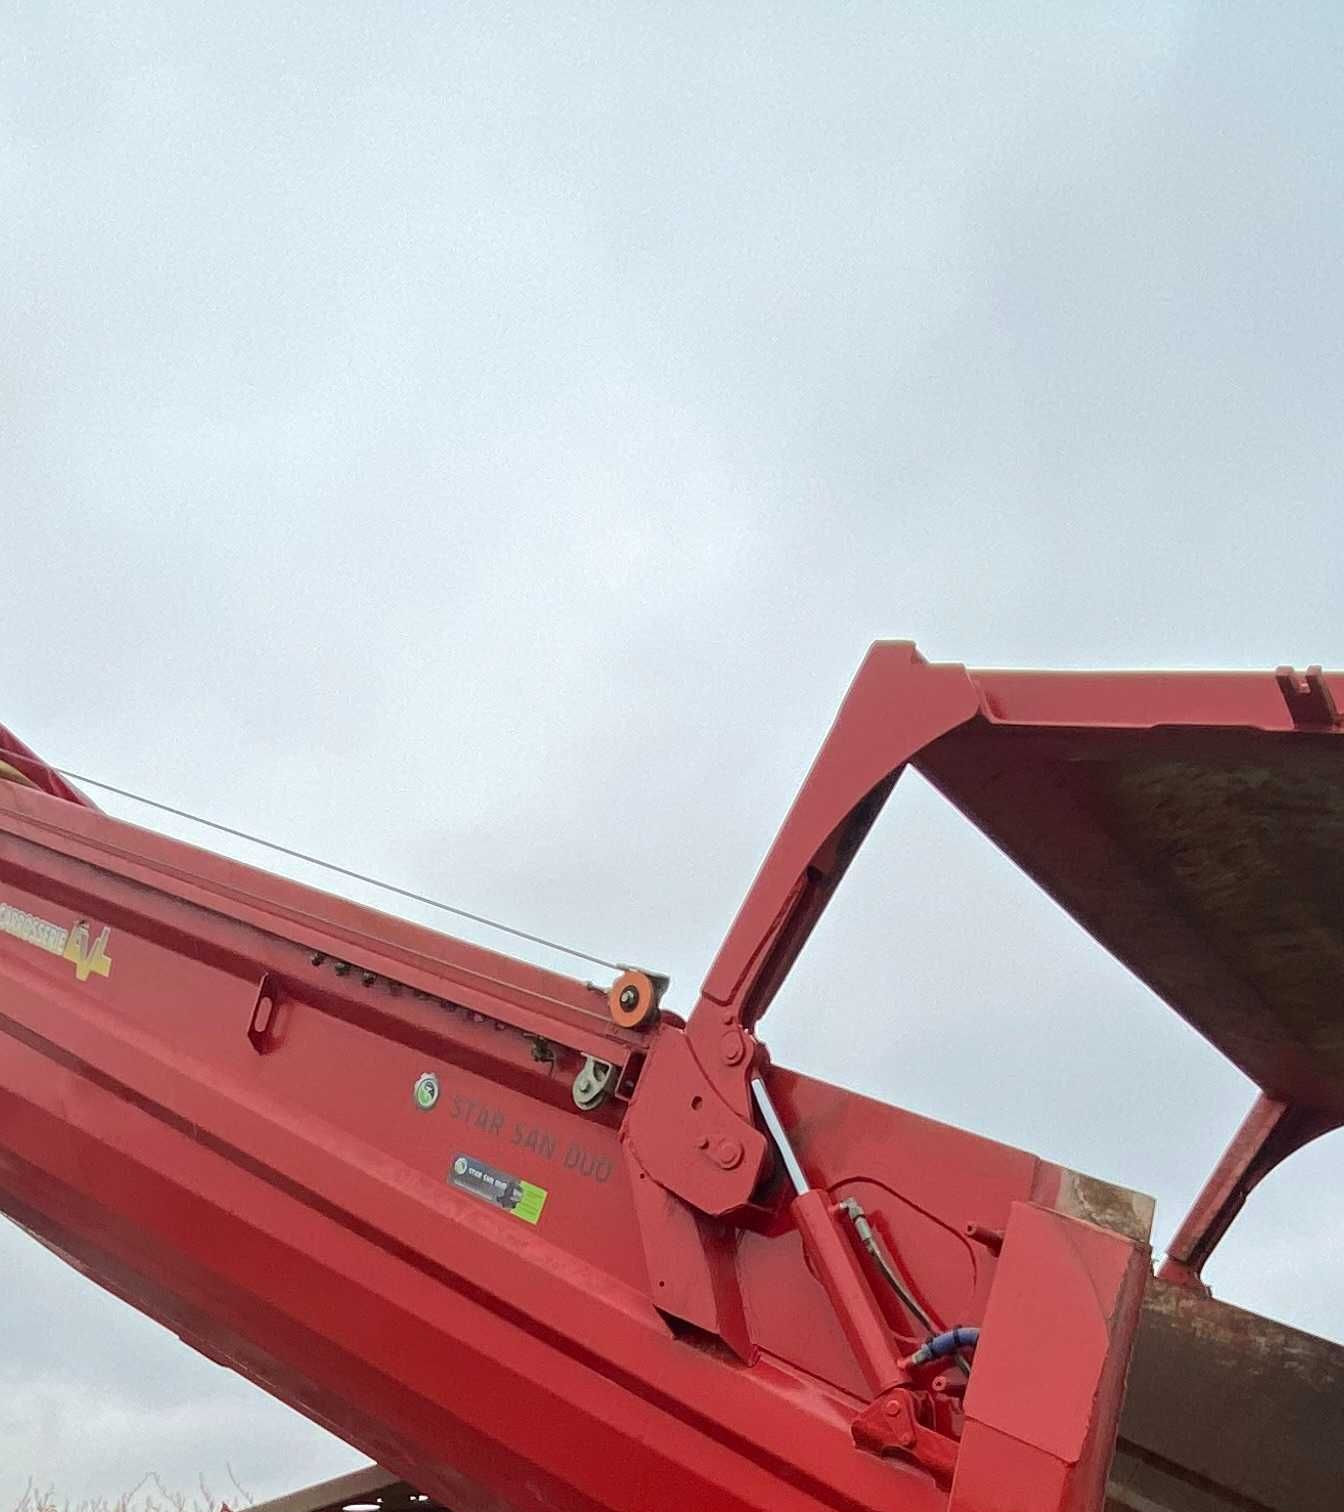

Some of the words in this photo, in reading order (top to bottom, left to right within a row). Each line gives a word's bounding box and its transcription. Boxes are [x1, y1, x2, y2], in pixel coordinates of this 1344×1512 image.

[450, 1097, 504, 1136] STAR
[511, 1120, 555, 1160] SAN
[564, 1142, 614, 1183] DUO
